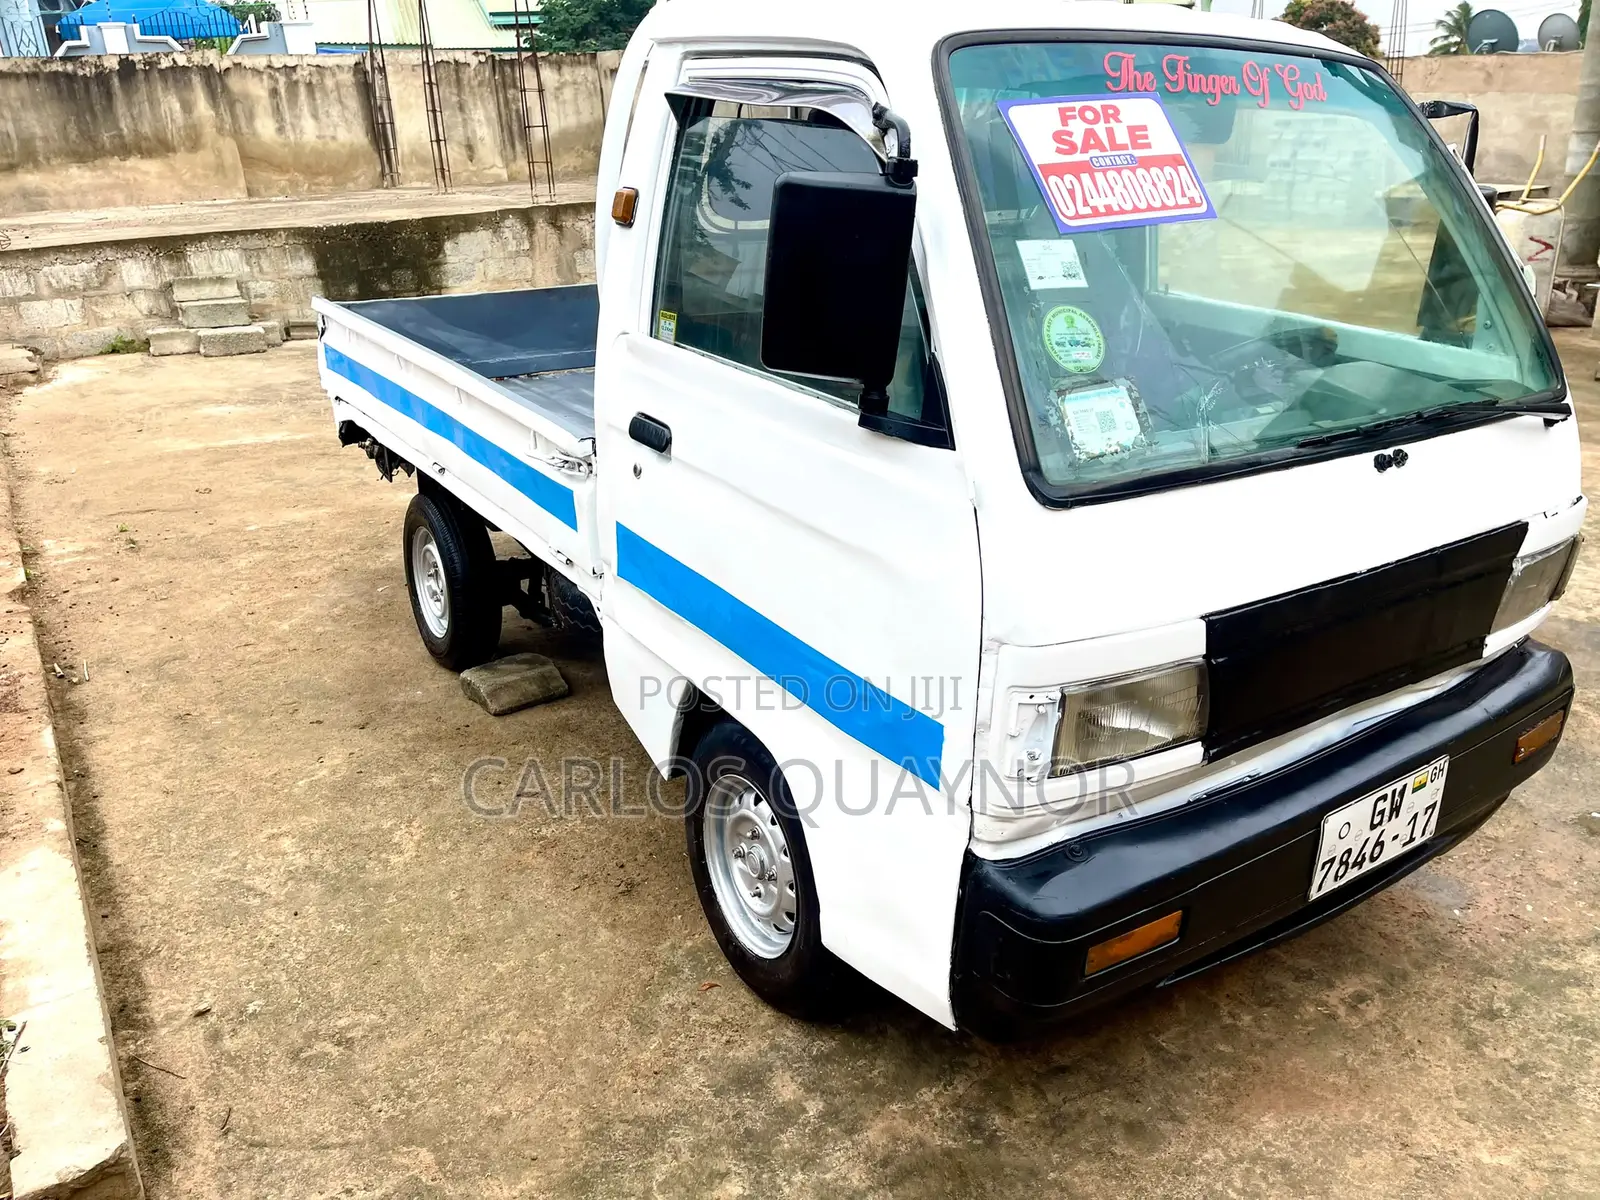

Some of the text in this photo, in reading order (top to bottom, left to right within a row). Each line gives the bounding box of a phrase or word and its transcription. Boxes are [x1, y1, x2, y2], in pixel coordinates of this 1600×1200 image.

[1103, 51, 1328, 110] The Finger Of God
[1057, 104, 1122, 127] FOR
[1052, 125, 1152, 156] SALE
[1091, 154, 1136, 168] CONTACT:
[1047, 165, 1203, 217] 0244808824
[1051, 308, 1078, 318] MUNICIPAL
[1430, 760, 1447, 784] GH
[1369, 783, 1408, 831] GW
[1316, 800, 1438, 893] 7846-17
